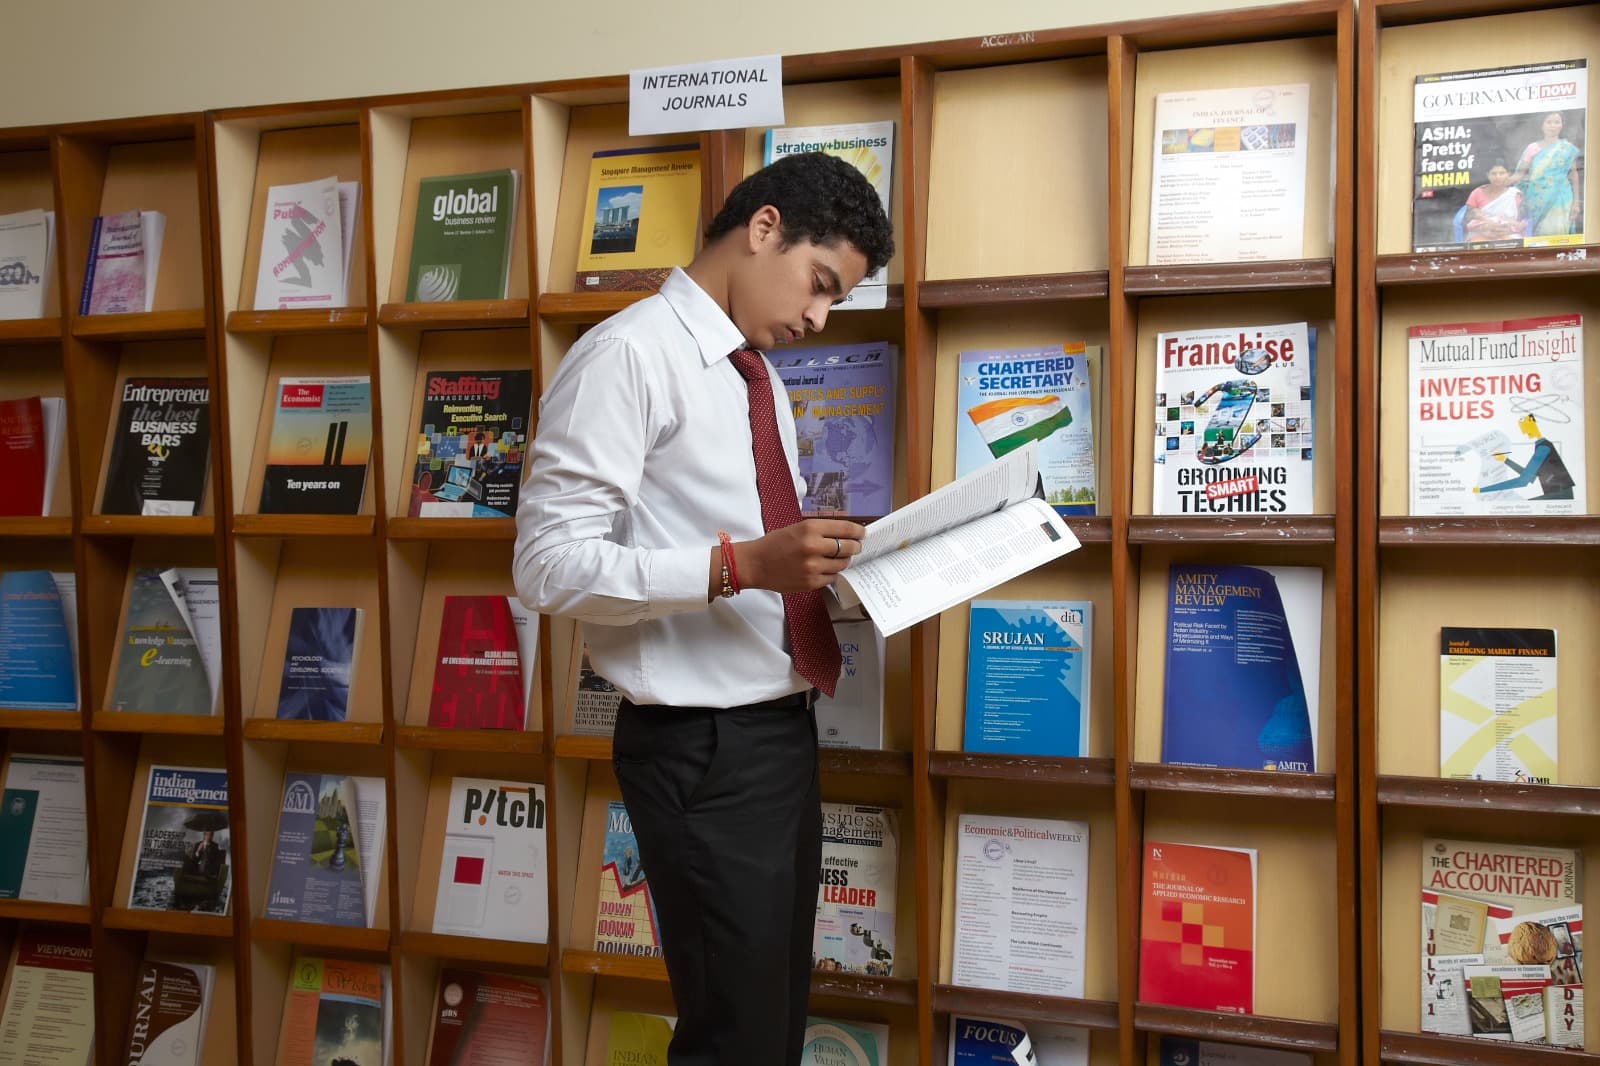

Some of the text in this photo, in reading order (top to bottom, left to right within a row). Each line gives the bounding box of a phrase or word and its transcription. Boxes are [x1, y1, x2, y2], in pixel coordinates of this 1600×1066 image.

[642, 69, 768, 90] INTERNATIONAL
[662, 93, 747, 111] JOURNALS
[1423, 84, 1574, 109] GOVERNANCE now
[1422, 125, 1472, 141] ASHA:
[776, 136, 887, 154] strategy+business
[1422, 141, 1472, 157] Pretty
[601, 163, 693, 176] Singapore Management Review
[1421, 155, 1474, 172] face of
[1421, 172, 1470, 187] NRHM
[433, 186, 498, 221] global
[445, 215, 496, 225] business review
[1165, 332, 1294, 368] Franchise
[1420, 330, 1576, 363] Mutual Fund Insight
[978, 357, 1075, 376] CHARTERED
[428, 376, 501, 400] Staffing
[780, 376, 801, 386] national
[979, 372, 1073, 390] SECRETARY
[1420, 373, 1541, 398] INVESTING
[123, 384, 209, 406] Entrepreneu
[826, 387, 846, 400] AND
[849, 384, 885, 398] SUPPLY
[132, 403, 200, 421] the best
[443, 404, 482, 413] Reinventing
[812, 403, 885, 417] MANAGEMENT
[1420, 400, 1495, 421] BLUES
[451, 413, 507, 422] Executive Search
[130, 422, 197, 434] BUSINESS
[141, 434, 181, 446] BARS
[1177, 467, 1287, 486] GROOMING
[287, 479, 340, 491] Ten years on
[1207, 477, 1256, 497] SMART
[1178, 490, 1287, 513] TECHIES
[1176, 574, 1217, 584] AMITY
[1176, 585, 1262, 598] MANAGEMENT
[1175, 595, 1226, 606] REVIEW
[1061, 612, 1076, 623] dit
[983, 632, 1045, 645] SRUJAN
[140, 649, 192, 667] e-learning
[1278, 761, 1308, 771] AMITY
[154, 773, 196, 788] indian
[152, 787, 228, 802] managemen
[822, 825, 883, 840] nagement
[824, 856, 858, 868] effective
[820, 867, 848, 886] NESS
[1431, 851, 1574, 899] THE CHARTERED JOURNAL
[1430, 870, 1562, 899] ACCOUNTANT
[824, 886, 876, 907] LEADER
[1179, 893, 1212, 901] ECONOMIC
[1213, 896, 1246, 904] RESEARCH
[600, 901, 632, 916] DOWN
[598, 920, 635, 939] DOWN
[36, 944, 93, 958] VIEWPOINT
[964, 1025, 1017, 1046] FOCUS
[614, 1050, 657, 1064] INDIAN
[814, 1043, 846, 1057] HUMAN
